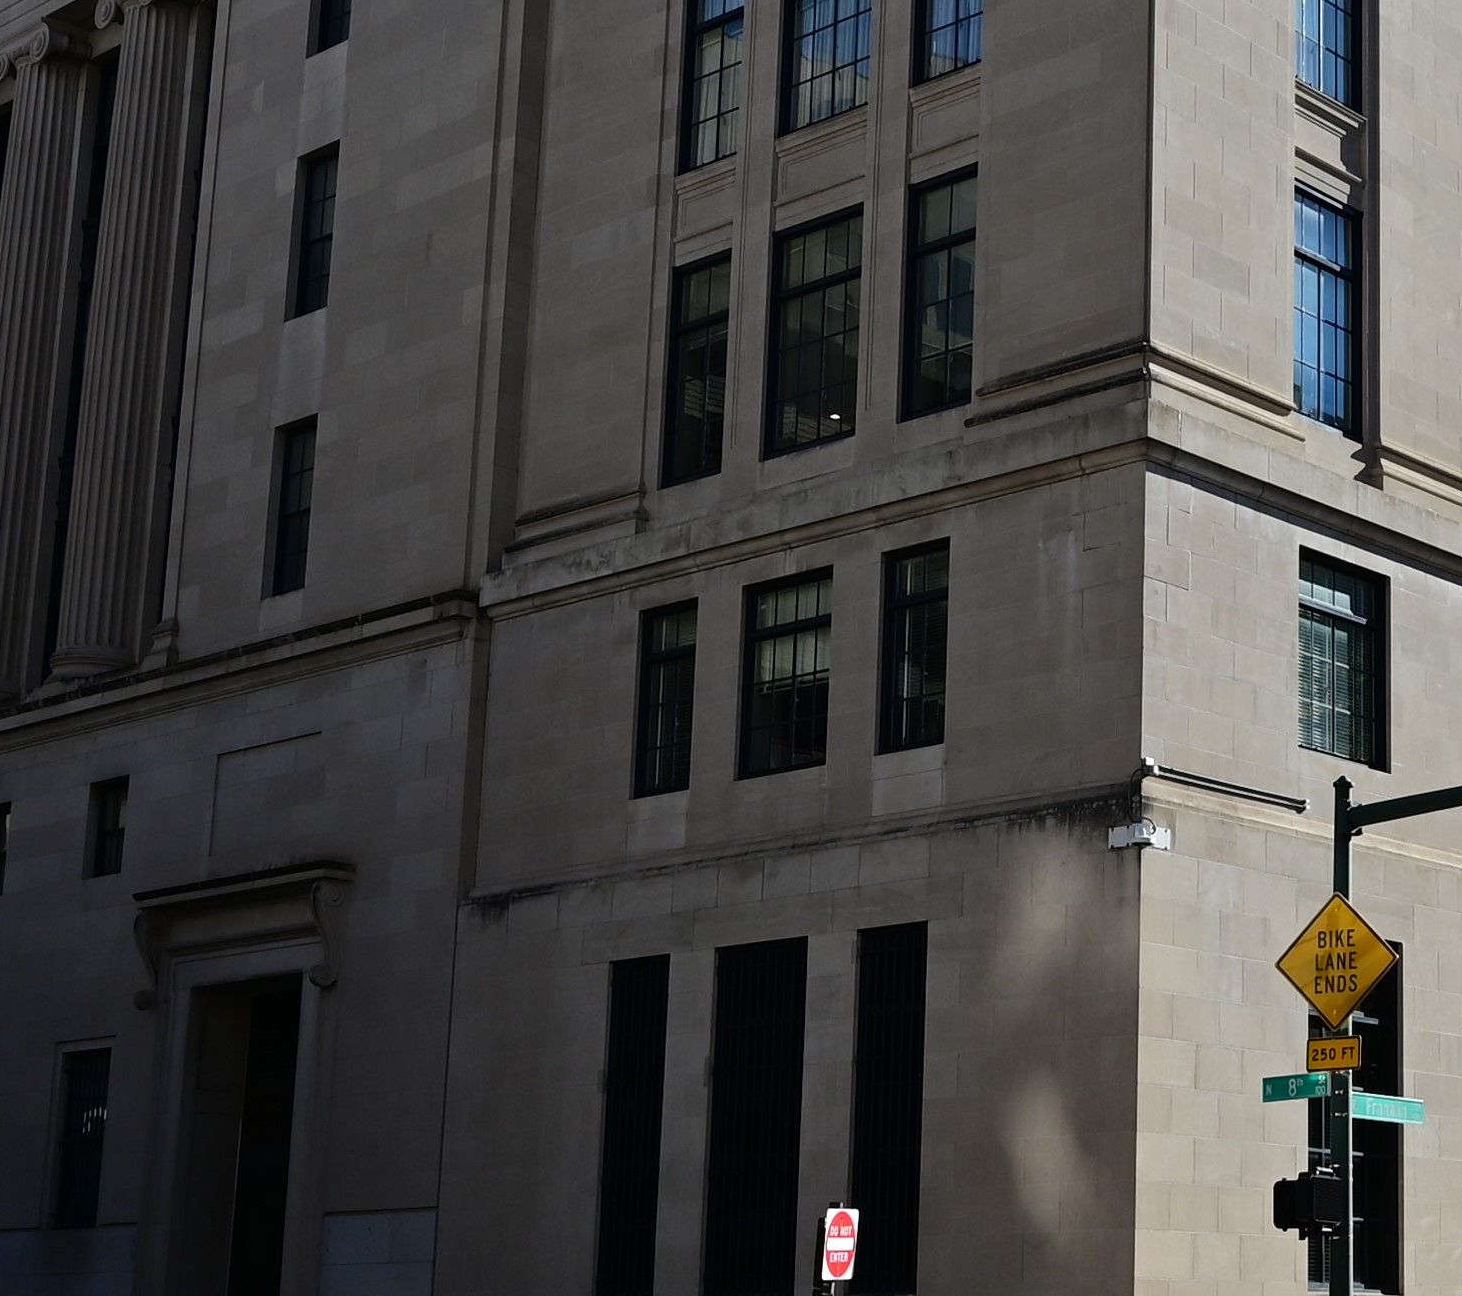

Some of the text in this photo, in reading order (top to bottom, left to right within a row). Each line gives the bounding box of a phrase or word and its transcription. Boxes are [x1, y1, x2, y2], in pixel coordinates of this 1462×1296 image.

[1317, 929, 1355, 949] BIKE
[1315, 951, 1358, 972] LANE
[1314, 974, 1358, 994] ENDS
[1311, 1046, 1356, 1061] 250 FT
[1266, 1084, 1272, 1095] N
[1288, 1078, 1303, 1097] 8th
[830, 1226, 852, 1237] DO NOT
[829, 1252, 849, 1263] ENTER
